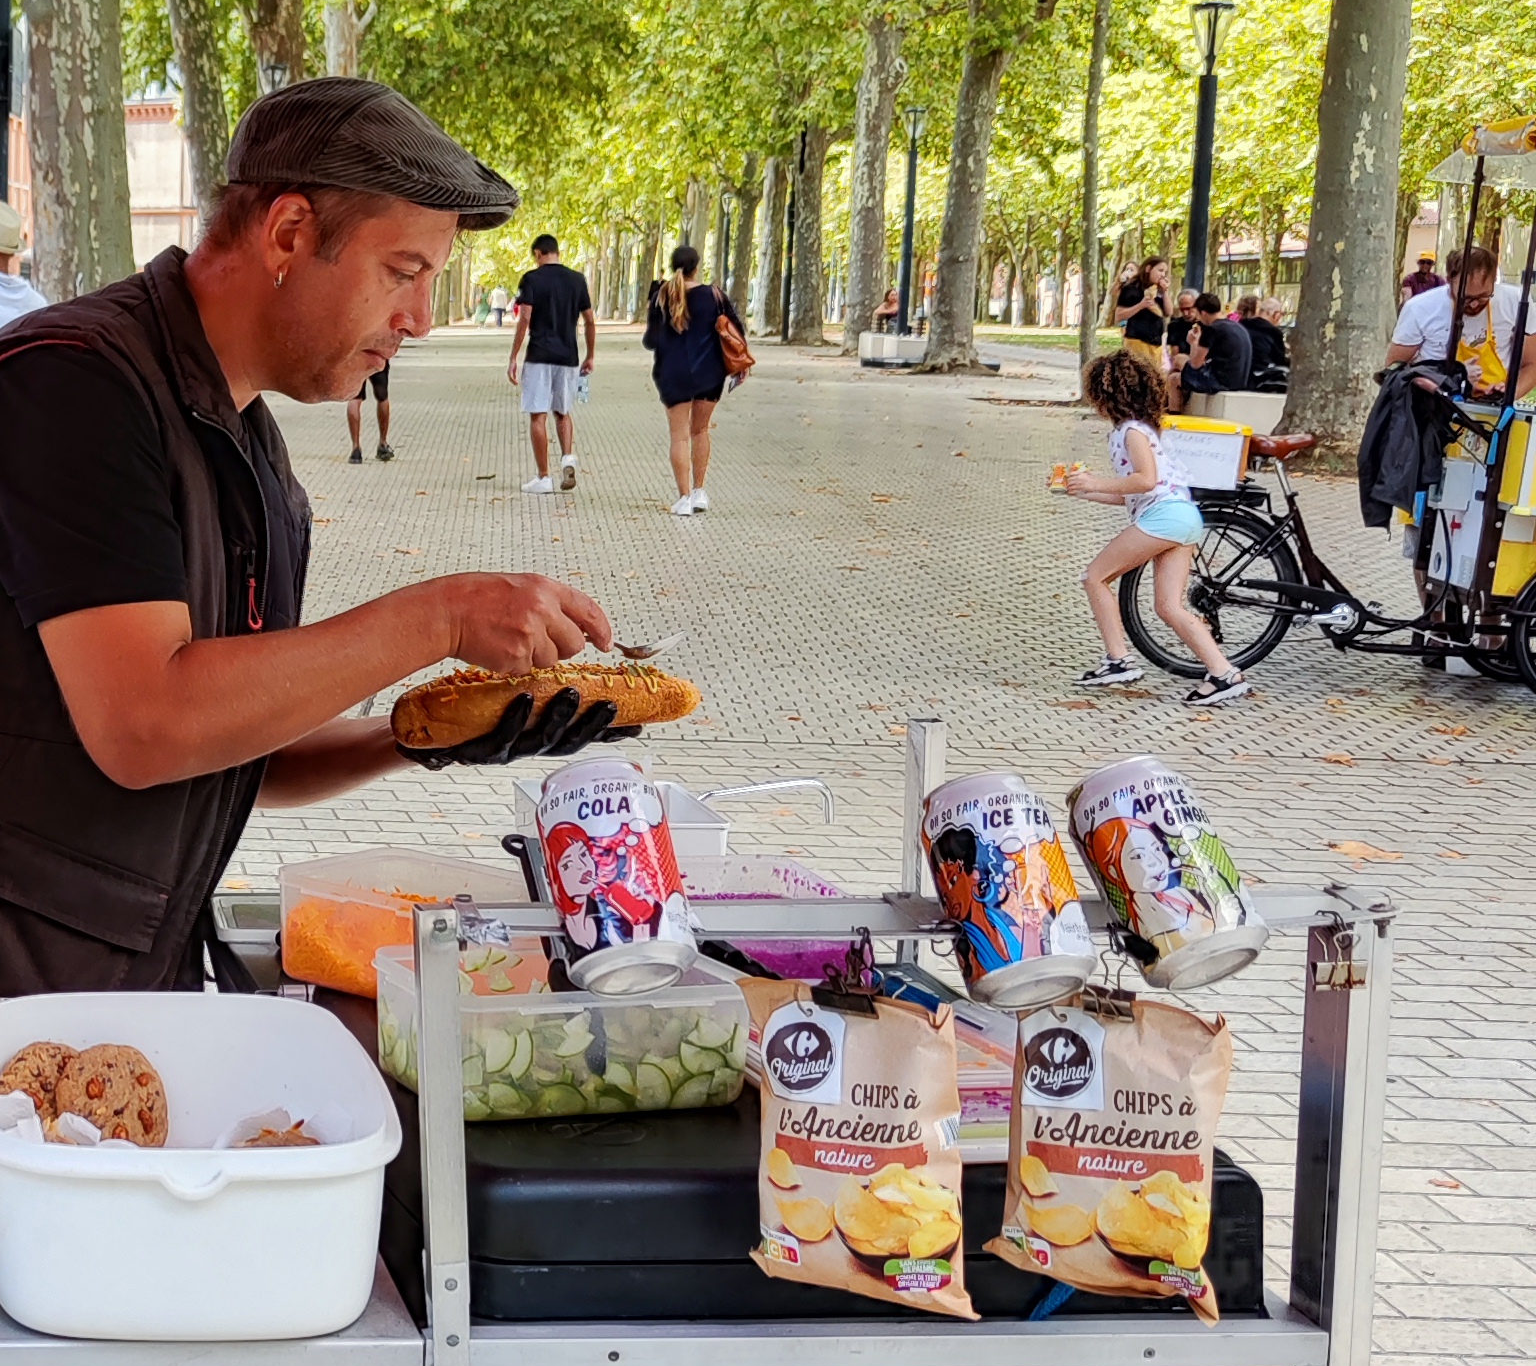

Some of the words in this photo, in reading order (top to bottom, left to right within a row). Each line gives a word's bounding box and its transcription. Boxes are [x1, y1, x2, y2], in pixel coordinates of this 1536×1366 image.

[550, 795, 561, 812] SO
[577, 796, 631, 821] COLA
[1098, 797, 1109, 812] SO
[941, 809, 953, 823] SO
[982, 808, 1014, 830] ICE
[1021, 808, 1051, 827] TEA
[771, 1050, 832, 1083] Original
[1026, 1057, 1092, 1090] Original
[851, 1083, 899, 1109] CHIPS
[903, 1088, 922, 1109] à
[1114, 1089, 1173, 1116] CHIPS
[1179, 1095, 1197, 1116] à
[814, 1148, 876, 1169] nature
[1078, 1153, 1147, 1174] nature
